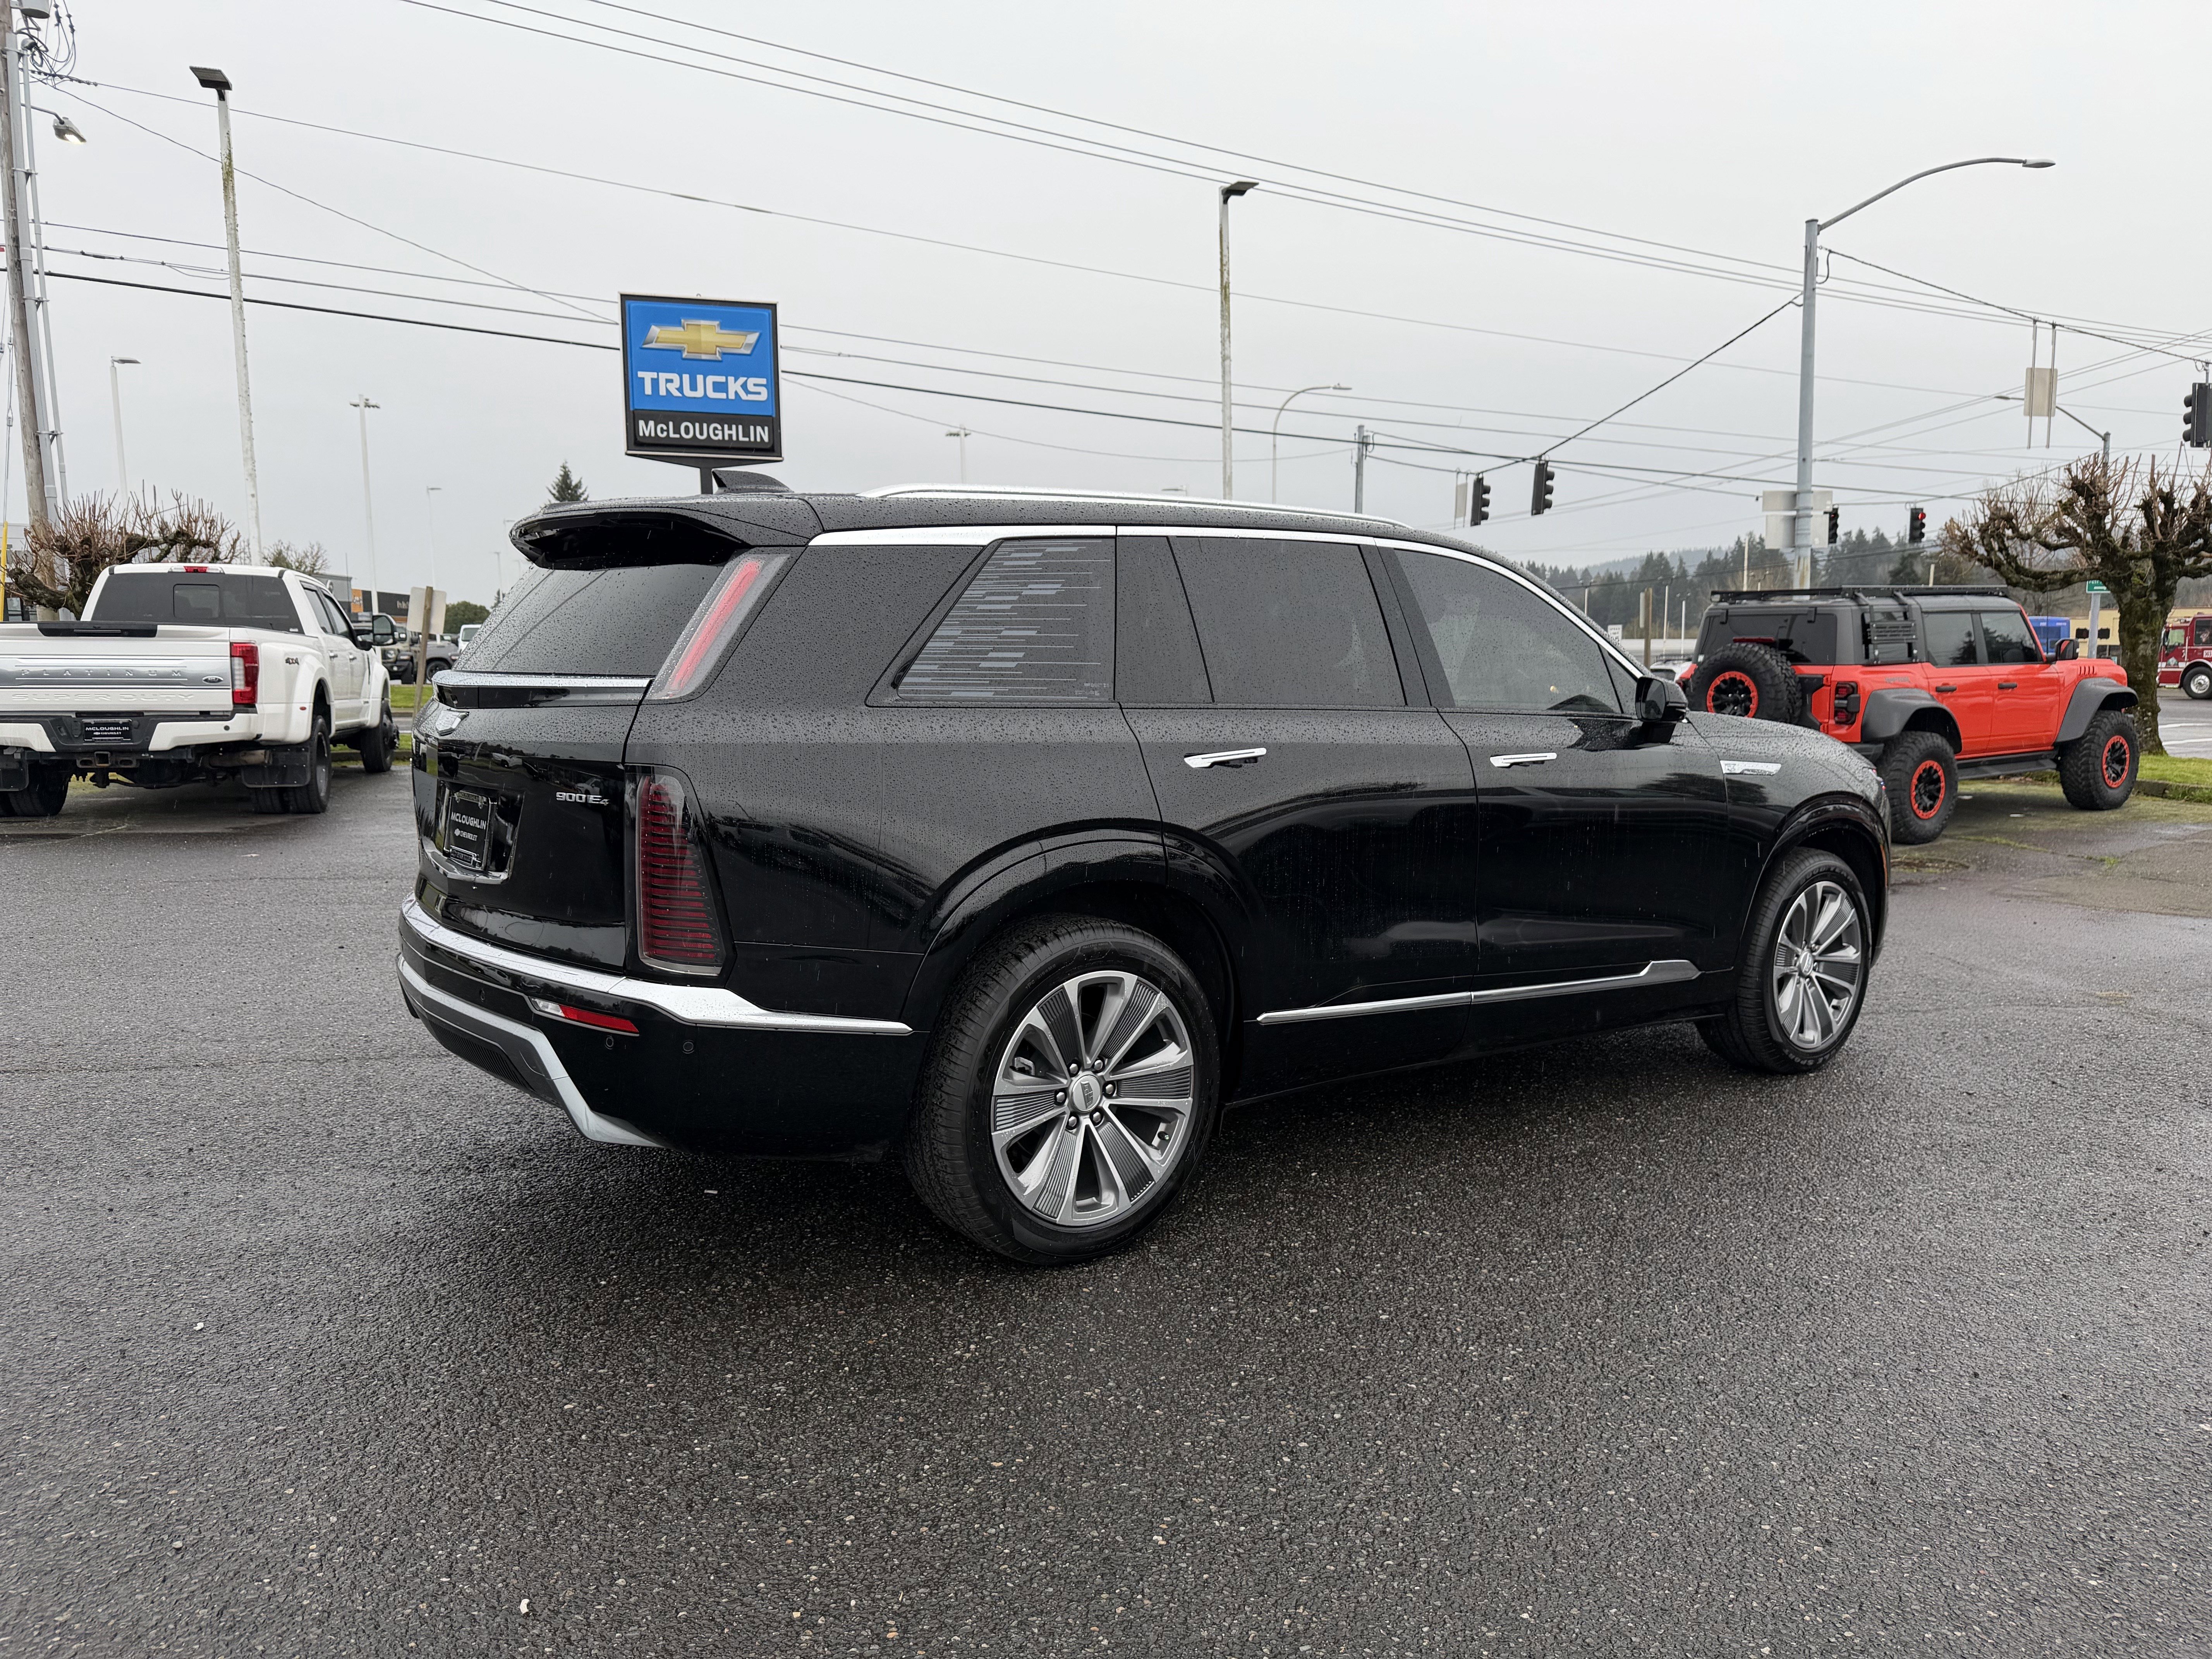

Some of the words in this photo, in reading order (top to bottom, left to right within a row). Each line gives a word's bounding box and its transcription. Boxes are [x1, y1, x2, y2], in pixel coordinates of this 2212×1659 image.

[637, 371, 768, 401] TRUCKS
[638, 420, 769, 443] McLOUGHLIN
[451, 812, 487, 830] MCLOUGHLIN
